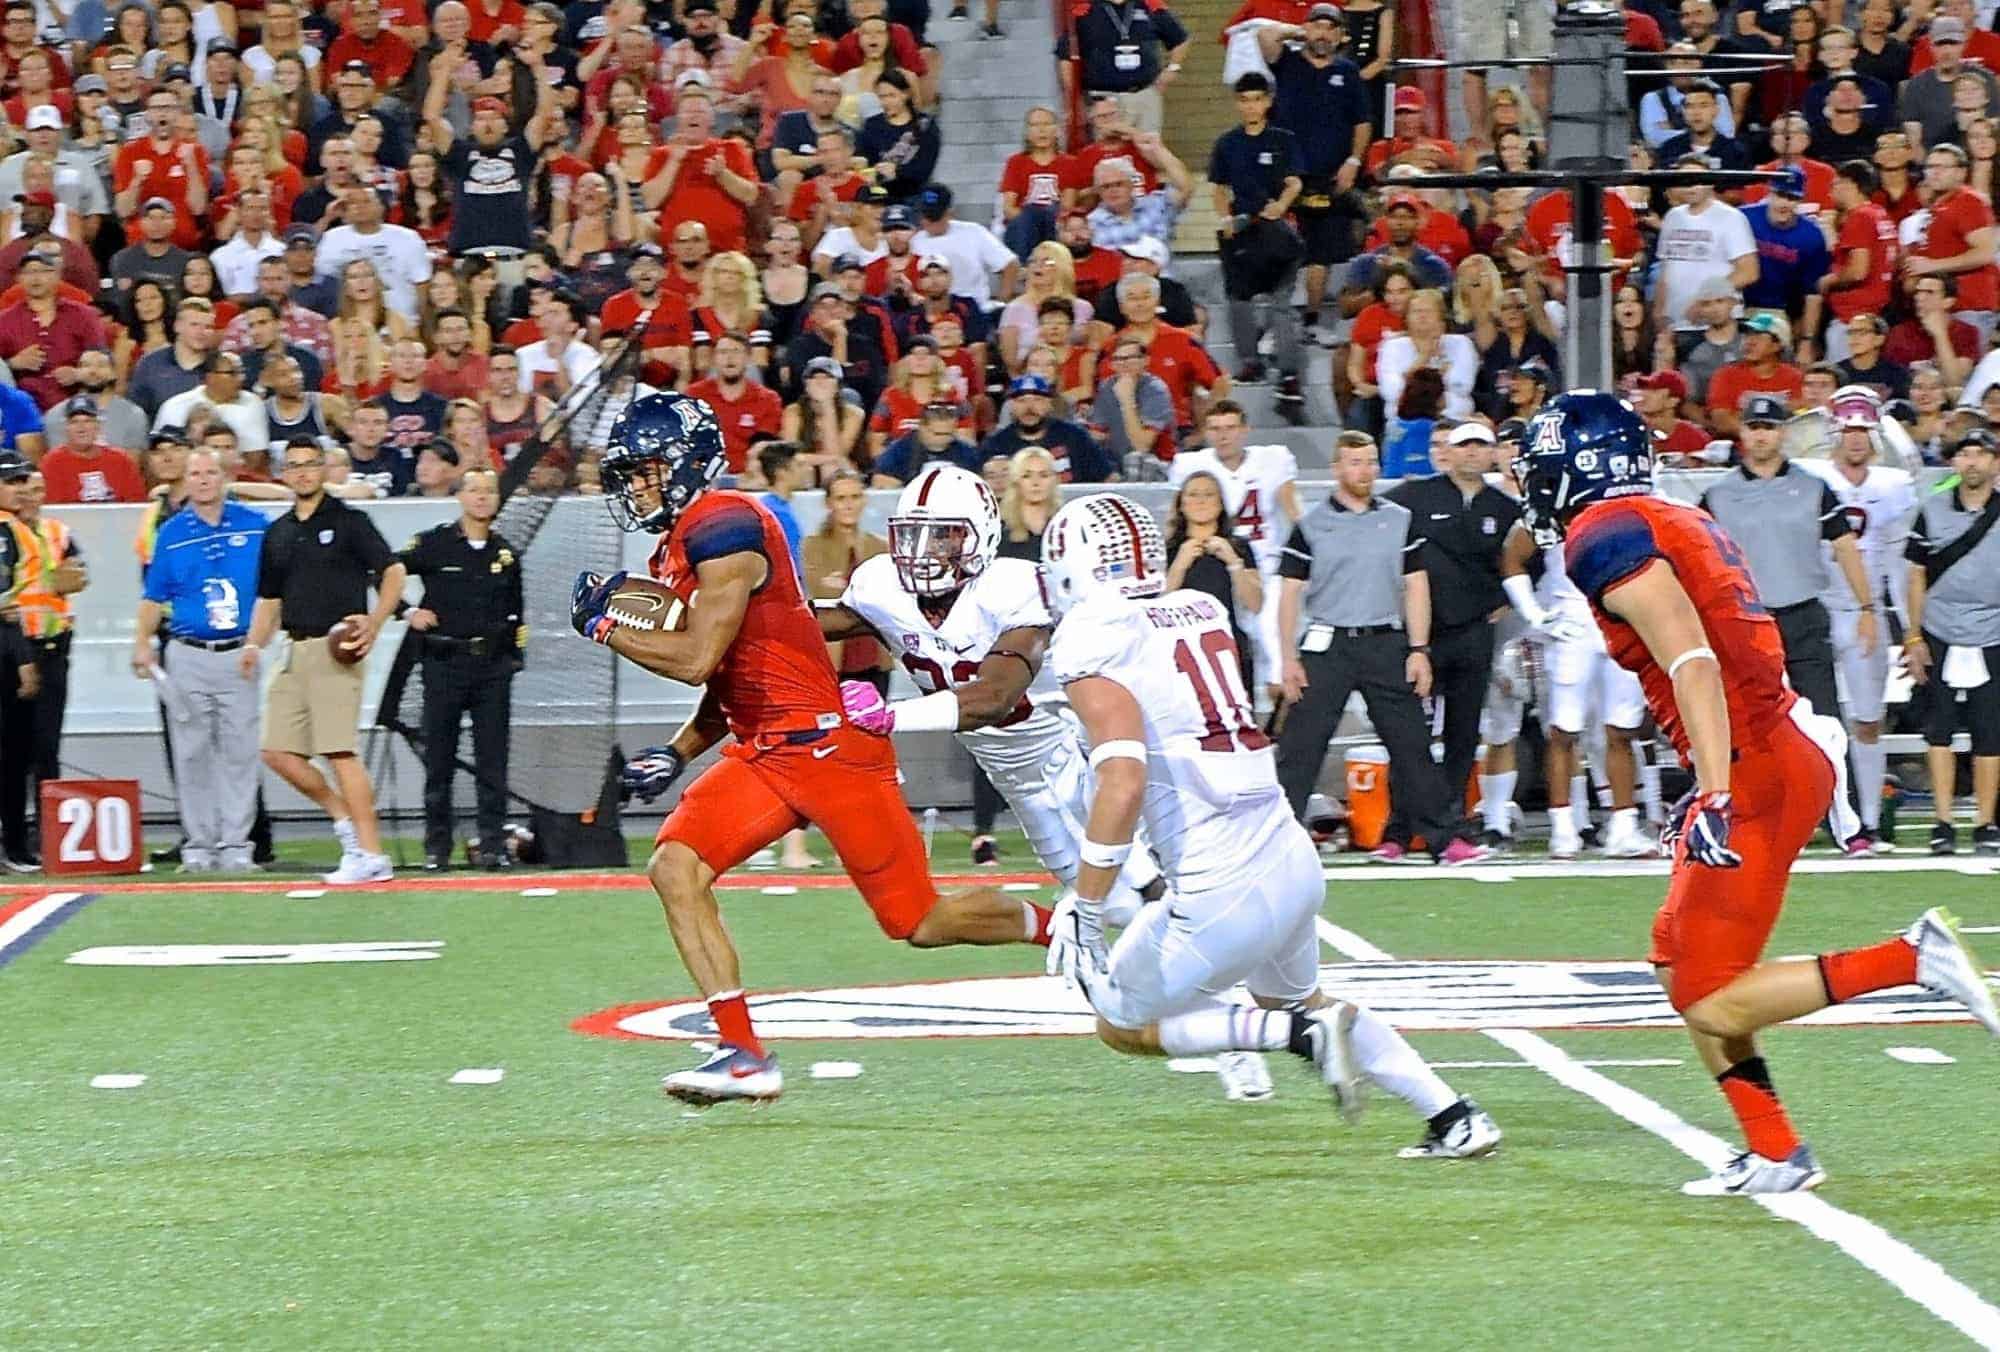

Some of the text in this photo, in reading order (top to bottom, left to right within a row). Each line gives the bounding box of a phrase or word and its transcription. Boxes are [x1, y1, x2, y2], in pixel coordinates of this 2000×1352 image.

[669, 398, 702, 437] A
[1529, 412, 1567, 456] A
[1173, 628, 1274, 752] 10
[57, 796, 133, 863] 20
